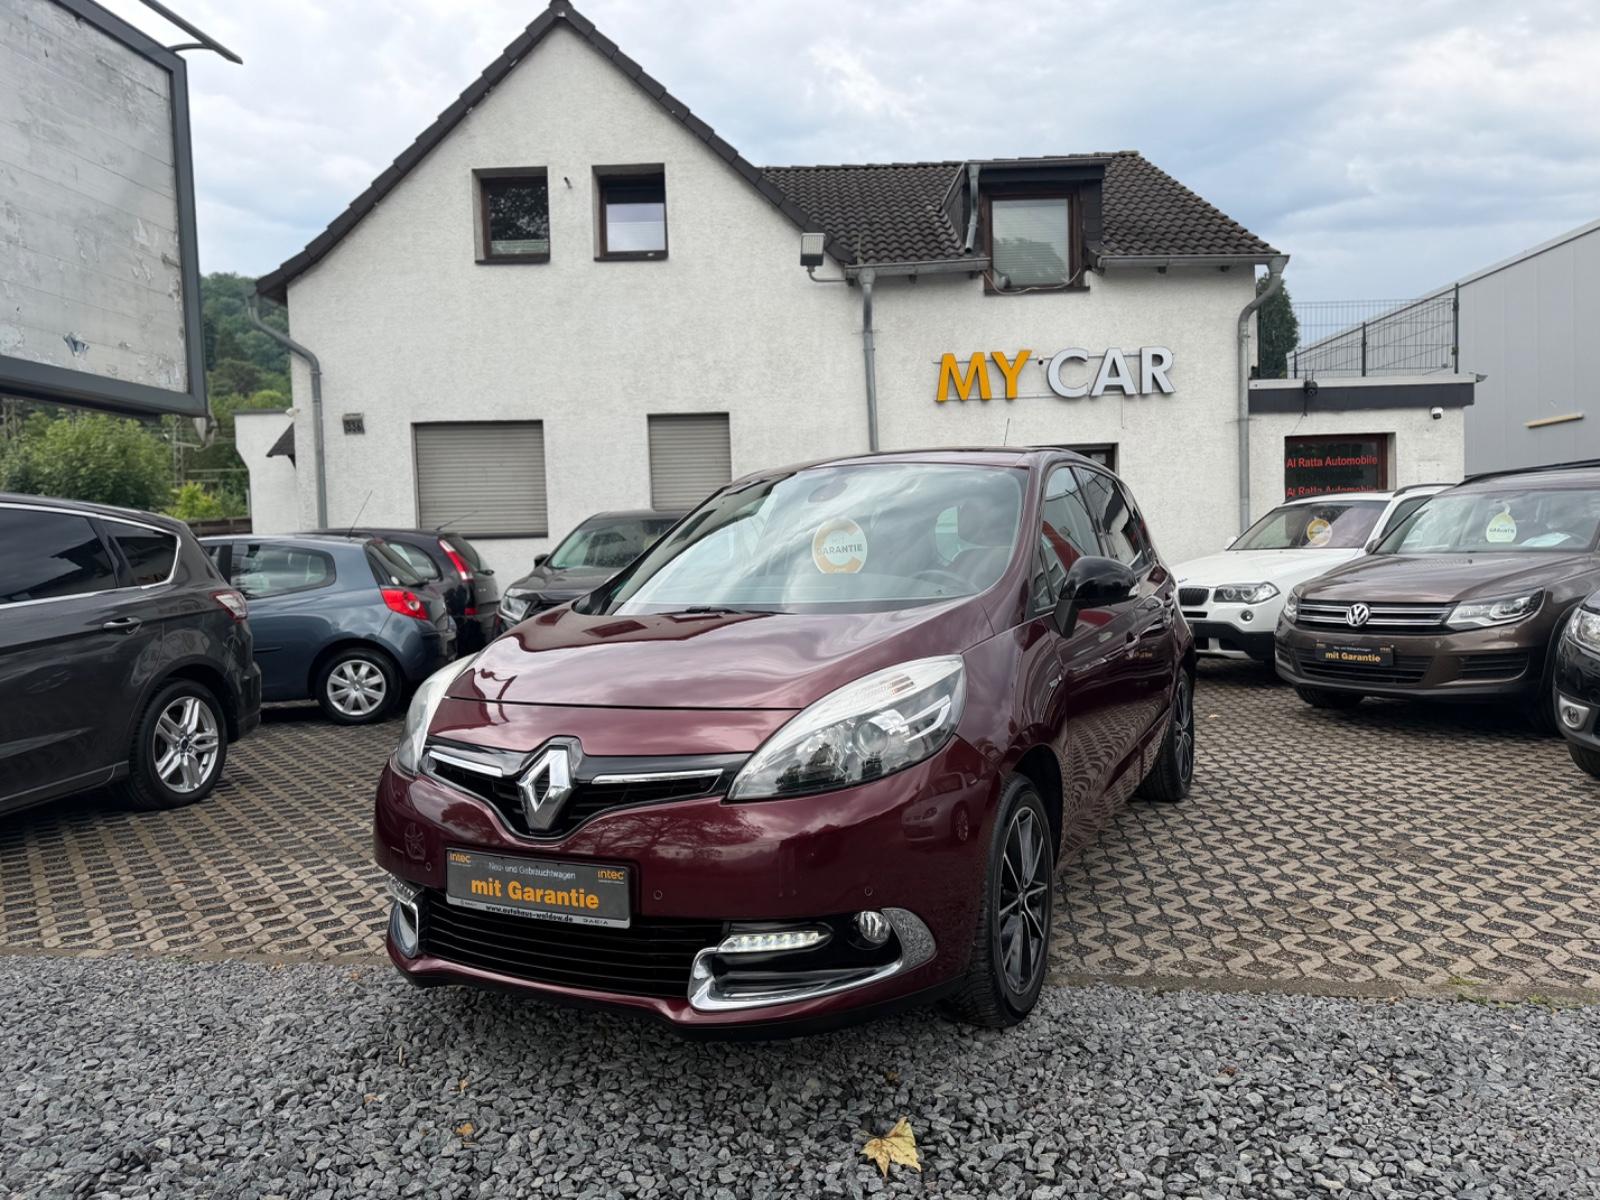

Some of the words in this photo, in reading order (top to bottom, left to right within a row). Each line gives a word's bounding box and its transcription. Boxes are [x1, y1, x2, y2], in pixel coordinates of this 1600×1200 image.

[936, 350, 1032, 402] MY
[1047, 346, 1176, 399] CAR
[1286, 458, 1296, 468] Al
[1298, 457, 1323, 468] Ratta
[1324, 455, 1378, 466] Automobile
[1325, 650, 1340, 660] mit
[1341, 652, 1381, 663] Garantie
[449, 852, 472, 864] intec
[597, 869, 625, 880] intec
[471, 877, 502, 897] mit
[507, 880, 599, 910] Garantie
